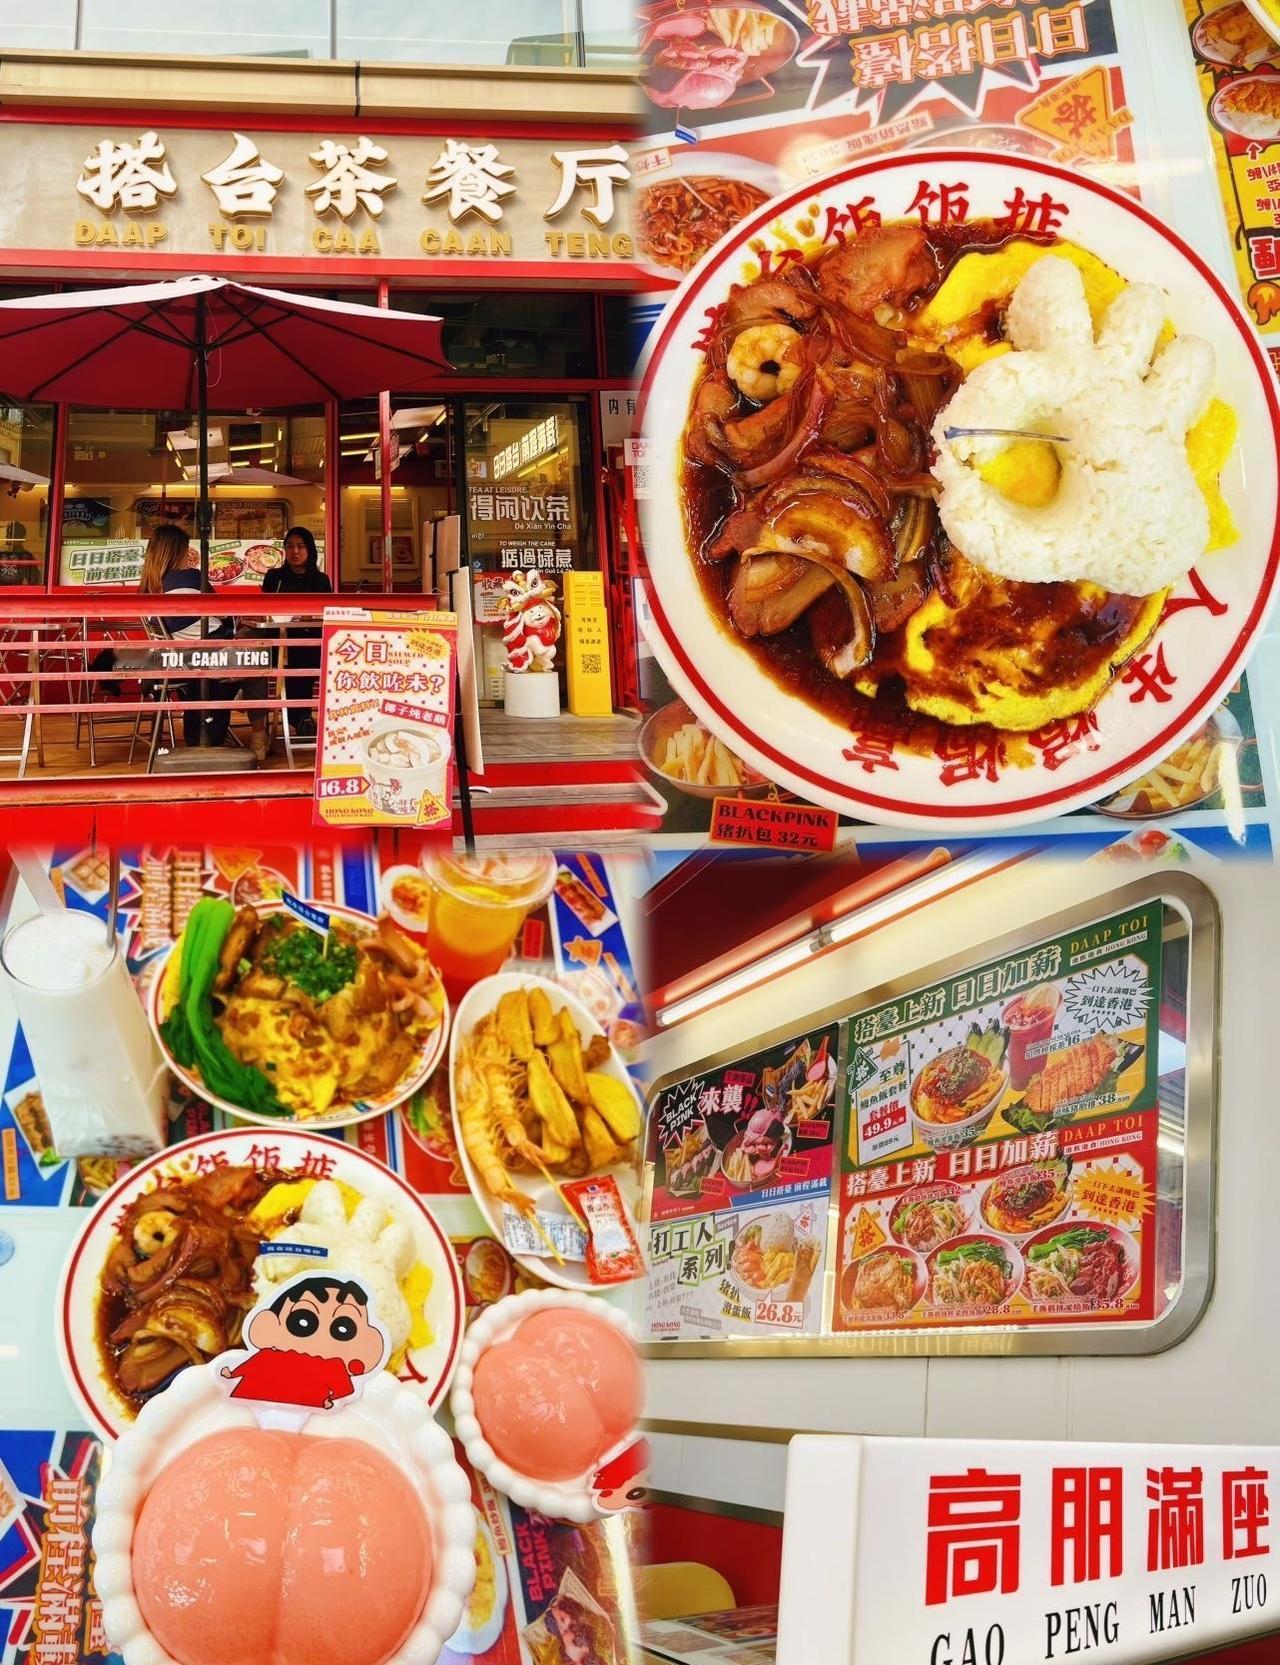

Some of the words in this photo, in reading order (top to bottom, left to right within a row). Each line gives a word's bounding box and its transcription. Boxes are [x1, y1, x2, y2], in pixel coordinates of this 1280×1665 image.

[77, 131, 631, 227] 搭台茶餐厅
[74, 220, 167, 247] DAAP
[210, 224, 265, 250] TOI
[312, 226, 380, 253] CAA
[421, 228, 511, 255] CAAN
[546, 231, 634, 258] TENG
[470, 495, 570, 520] 得闲饮茶
[161, 652, 183, 667] TOI
[192, 652, 228, 667] CAAN
[236, 651, 269, 666] TENG
[335, 638, 389, 663] 今日
[319, 779, 360, 797] 16.8
[719, 804, 829, 828] BLACKPINK
[778, 831, 819, 847] 32元
[1070, 929, 1112, 954] DAAP
[1119, 915, 1150, 936] TOI
[1105, 941, 1125, 953] HONG
[1126, 933, 1147, 945] KONG
[854, 988, 946, 1044] 搭臺上新
[951, 946, 1063, 1012] 日日加薪
[1081, 995, 1134, 1010] 到達香港
[666, 1091, 698, 1123] BLACK
[670, 1105, 694, 1131] PINK
[1064, 1123, 1107, 1142] DAAP
[1113, 1115, 1143, 1132] TOI
[1099, 1137, 1120, 1147] HONG
[1121, 1133, 1142, 1143] KONG
[847, 1154, 937, 1198] 搭臺上新
[949, 1129, 1060, 1178] 日日加薪
[1081, 1189, 1137, 1212] 到達香港
[653, 1222, 713, 1255] 打工人
[925, 1466, 1270, 1606] 高朋滿座
[515, 1522, 542, 1601] BLACK
[931, 1623, 1006, 1665] GAO
[1045, 1600, 1119, 1658] PENG
[1149, 1586, 1197, 1634] MAN
[1231, 1572, 1268, 1614] ZUO
